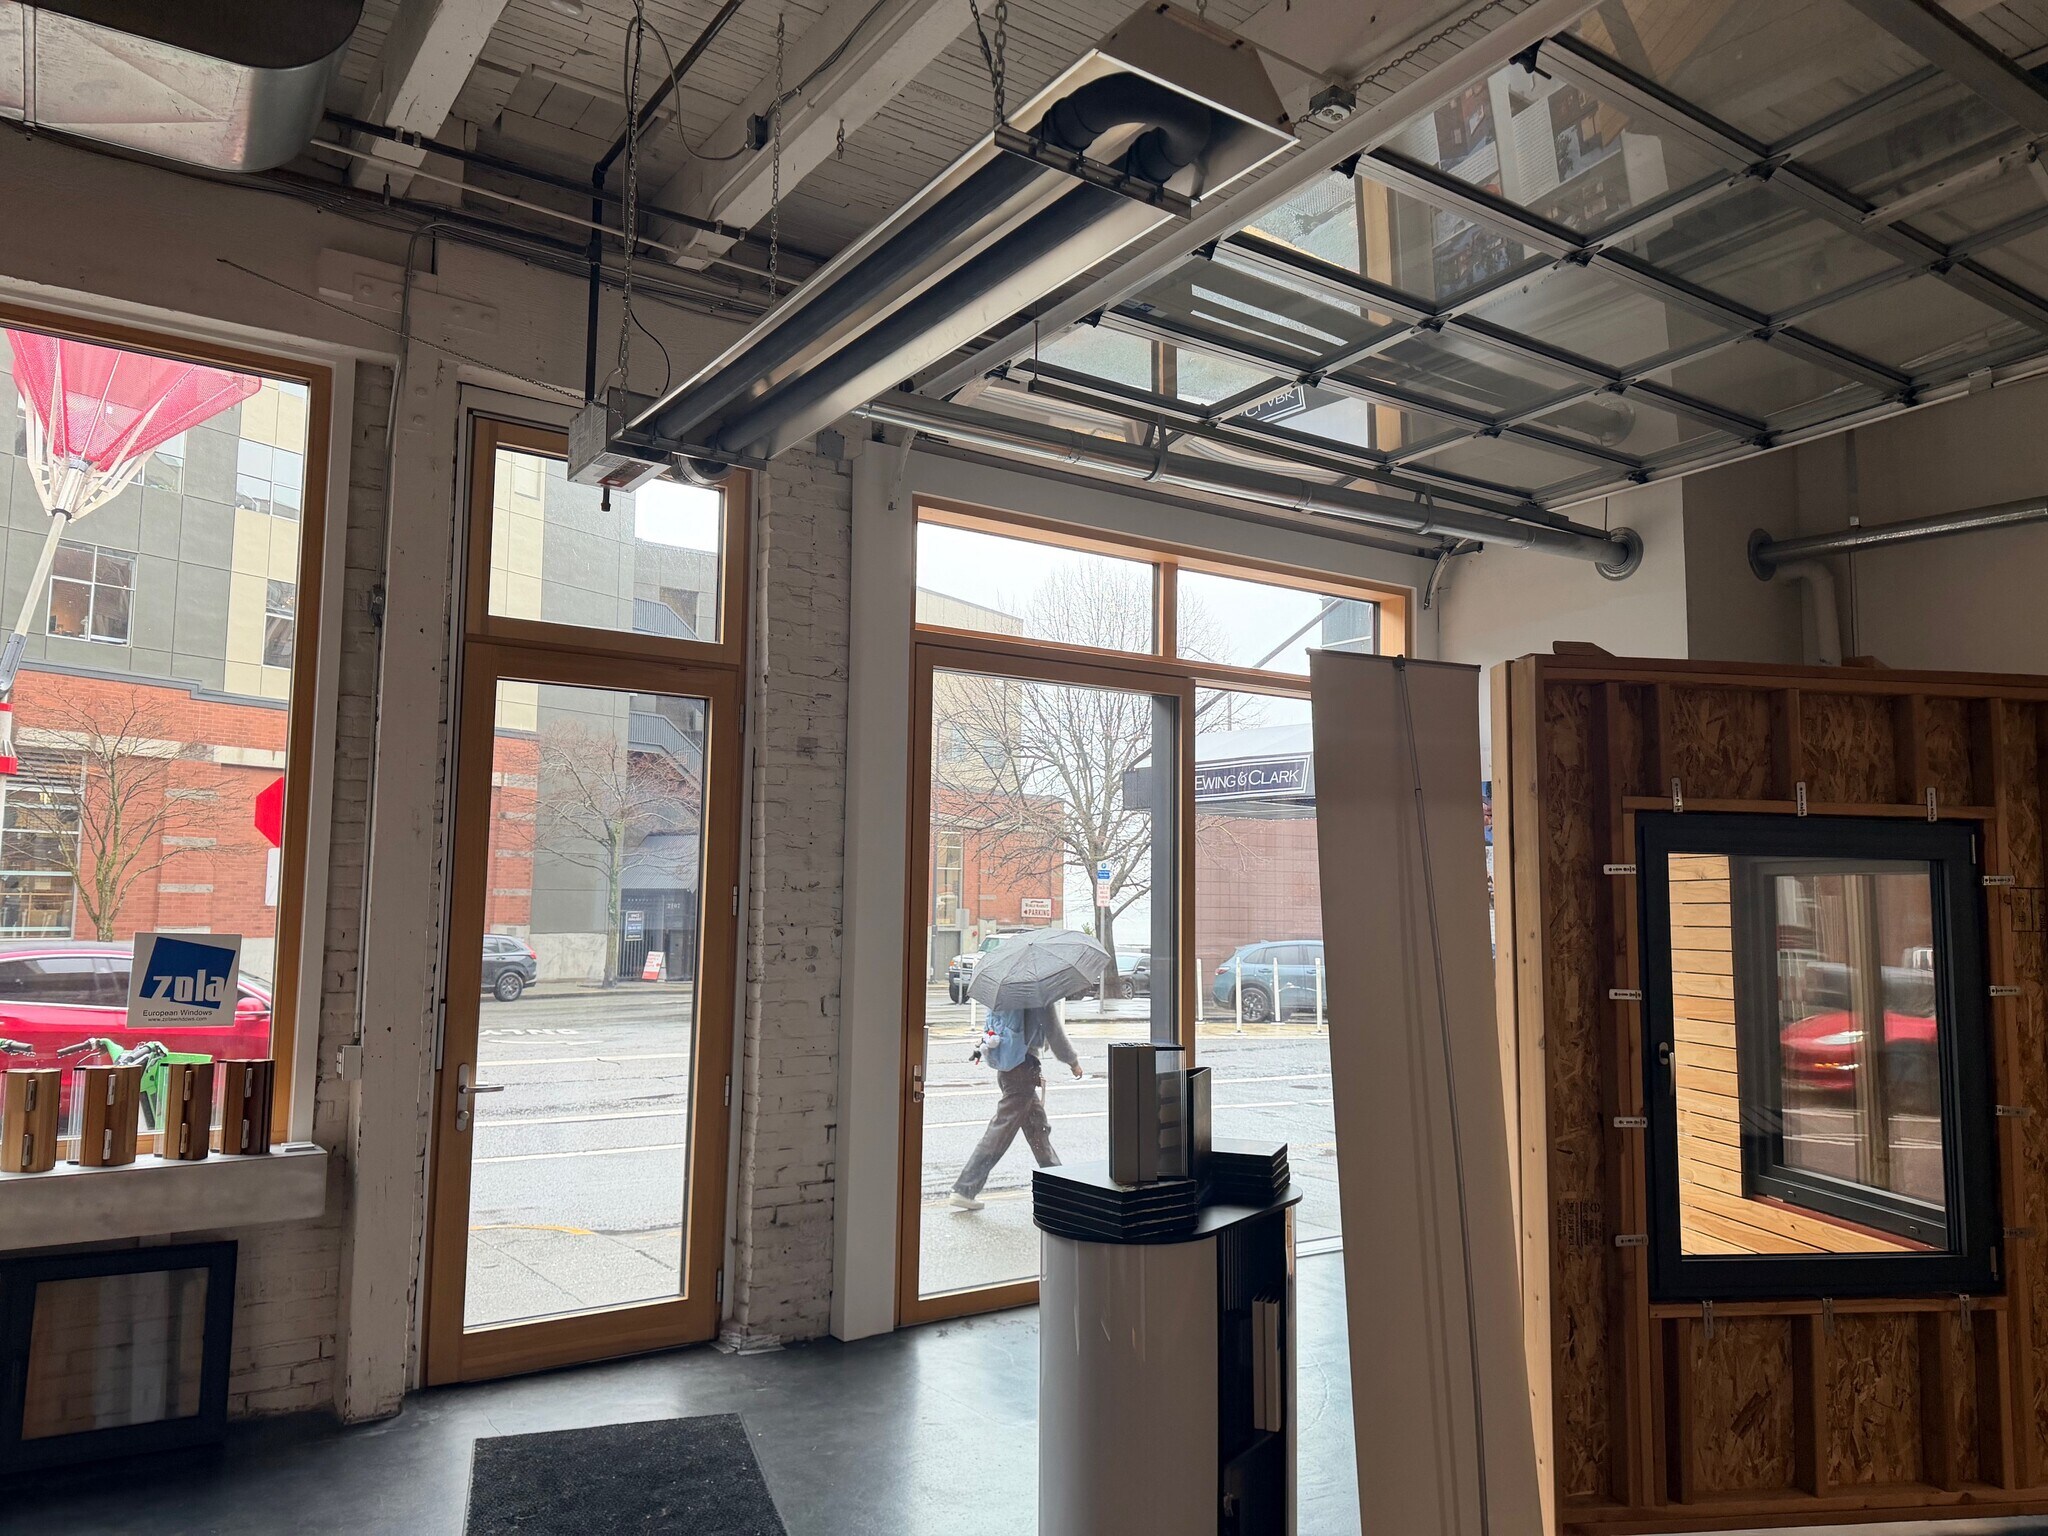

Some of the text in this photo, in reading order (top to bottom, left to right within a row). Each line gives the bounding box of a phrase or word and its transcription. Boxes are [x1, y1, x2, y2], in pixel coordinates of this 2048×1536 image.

[1237, 771, 1248, 786] &
[1248, 769, 1300, 786] CLARK
[142, 1009, 178, 1018] European
